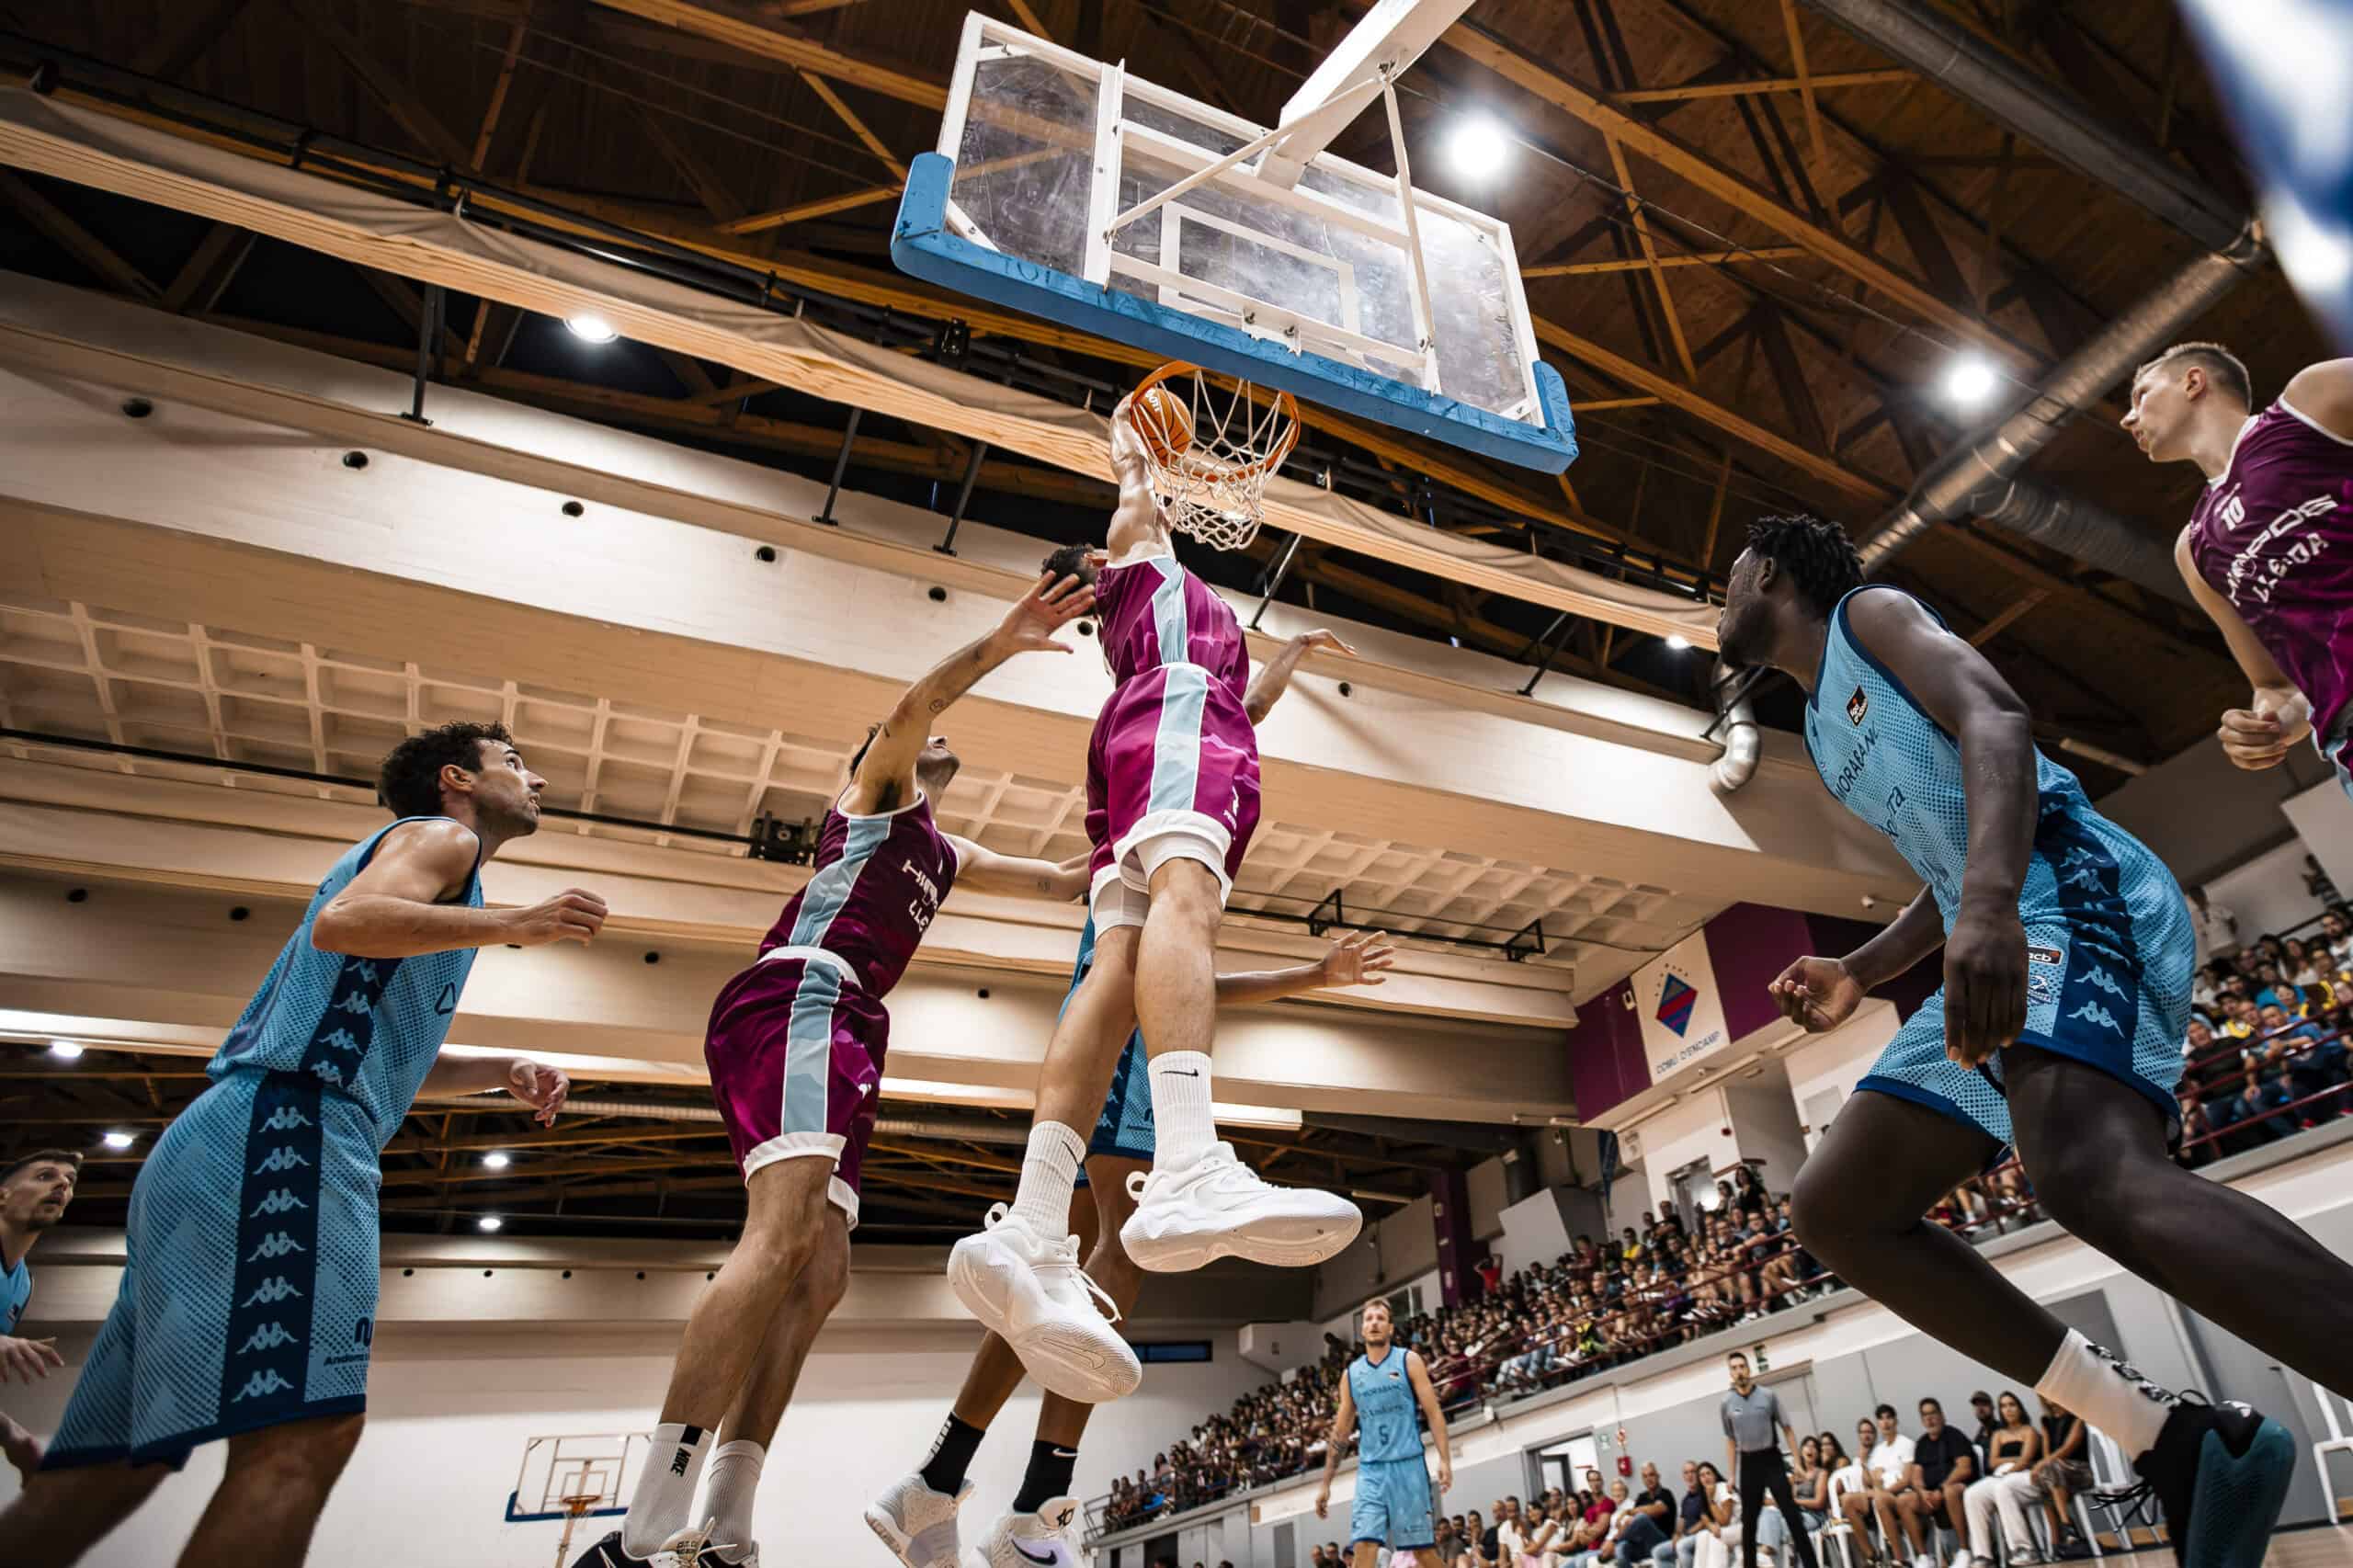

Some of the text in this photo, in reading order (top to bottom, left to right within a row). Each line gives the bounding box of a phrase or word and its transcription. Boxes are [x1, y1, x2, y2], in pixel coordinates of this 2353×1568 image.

[2220, 496, 2245, 531] 10
[1379, 1424, 1389, 1446] 5
[670, 1447, 691, 1477] NIKE
